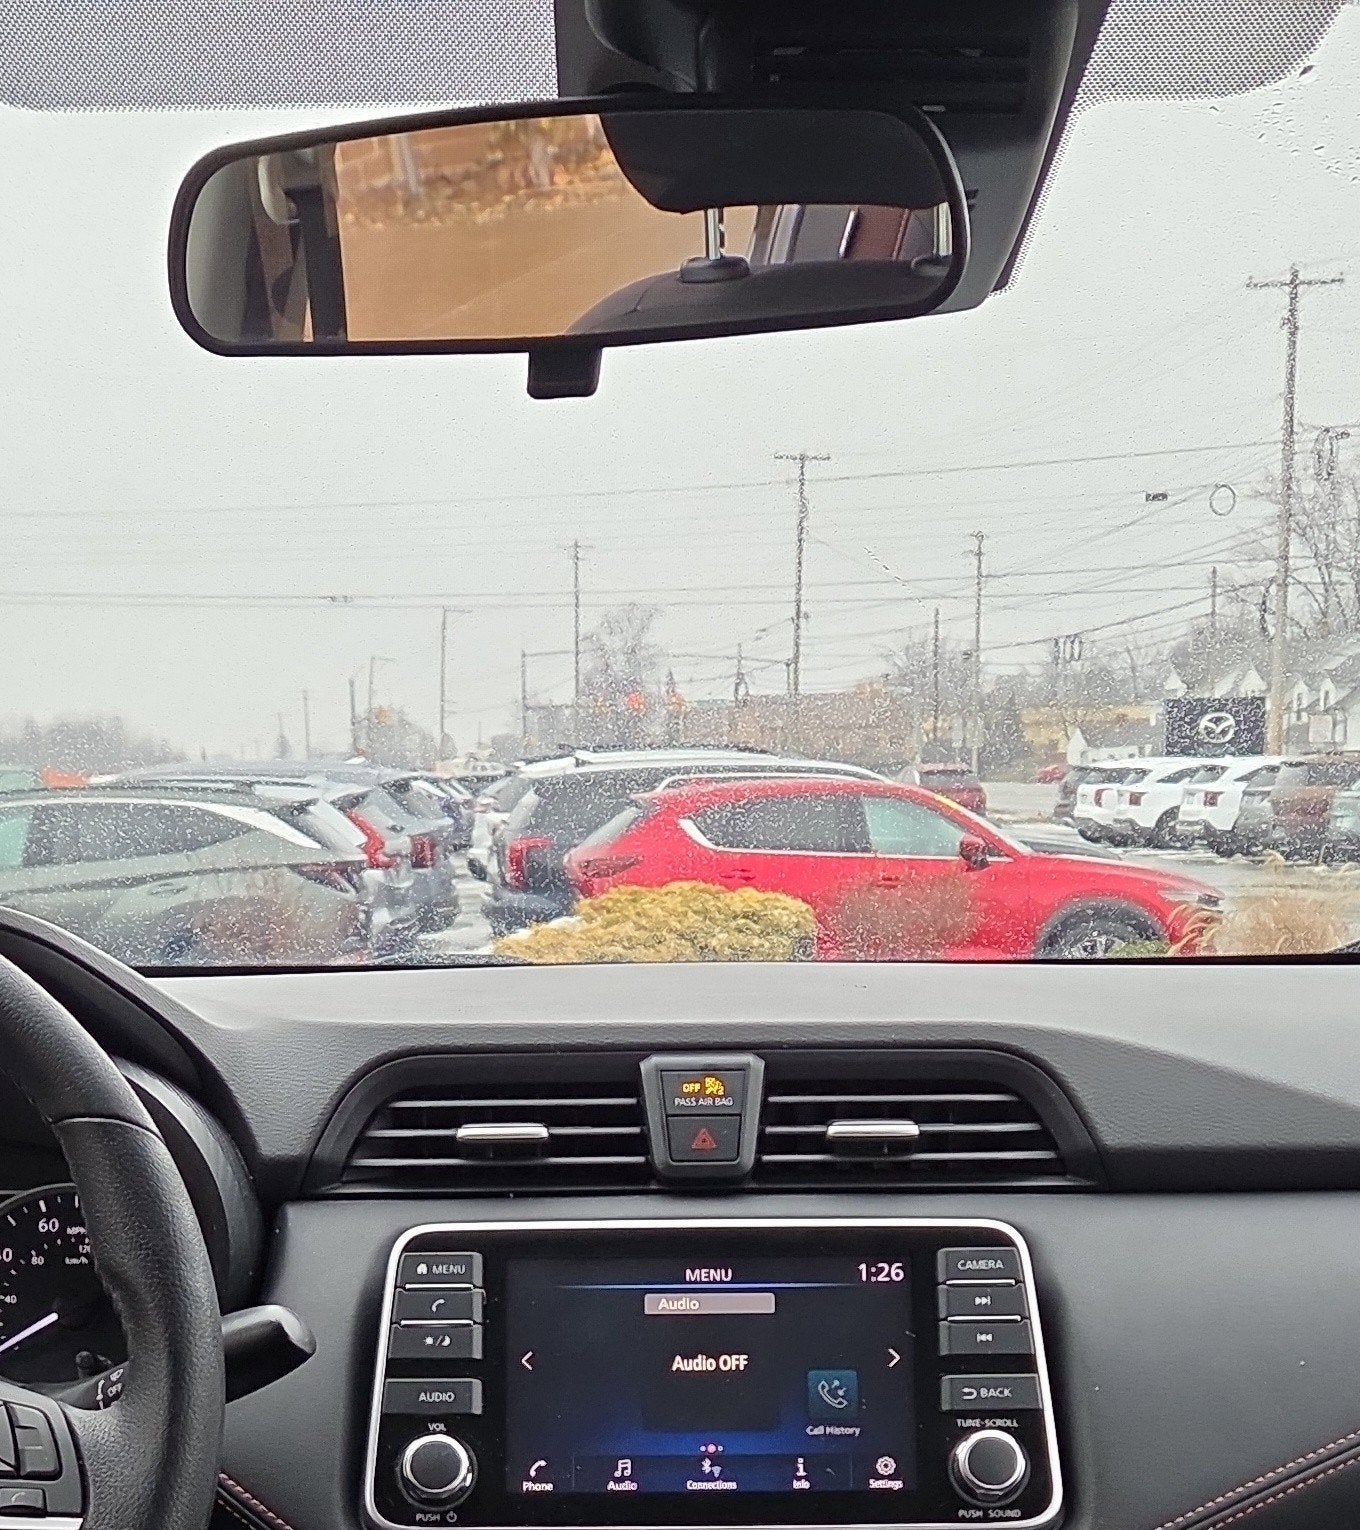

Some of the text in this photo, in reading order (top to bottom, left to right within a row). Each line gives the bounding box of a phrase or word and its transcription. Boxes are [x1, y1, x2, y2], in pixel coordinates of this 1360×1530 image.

[682, 1083, 701, 1093] OFF
[674, 1097, 697, 1107] PASS
[715, 1097, 734, 1106] BAG
[38, 1218, 60, 1233] 60
[31, 1256, 45, 1266] 80
[957, 1259, 1005, 1271] CAMERA
[431, 1264, 466, 1275] MENU
[685, 1268, 733, 1282] MENU
[857, 1262, 905, 1283] 1:26
[4, 1295, 18, 1304] 40
[658, 1298, 700, 1311] Audio
[671, 1354, 749, 1372] Audio OFF
[418, 1391, 455, 1403] AUDIO
[980, 1387, 1013, 1399] BACK
[428, 1422, 447, 1432] VOL
[806, 1425, 861, 1437] Call History
[522, 1481, 554, 1492] Phone
[607, 1480, 638, 1491] Audio
[686, 1479, 738, 1491] Connections
[869, 1478, 904, 1491] Settings
[416, 1513, 441, 1523] PUSH
[958, 1508, 1022, 1519] PUSH SOUND
